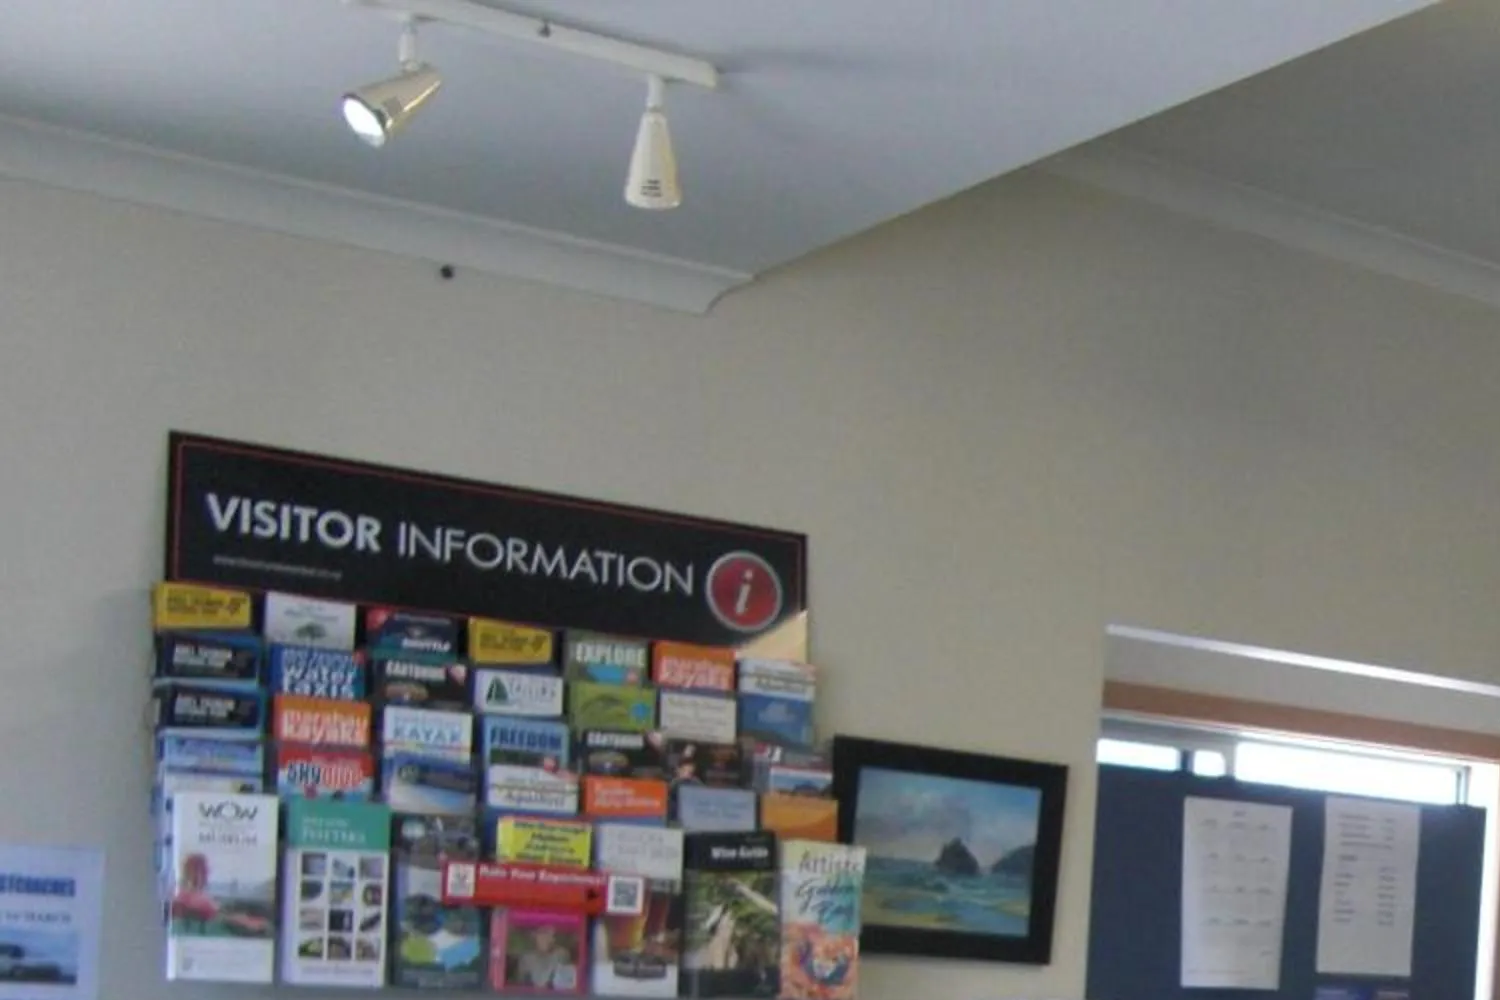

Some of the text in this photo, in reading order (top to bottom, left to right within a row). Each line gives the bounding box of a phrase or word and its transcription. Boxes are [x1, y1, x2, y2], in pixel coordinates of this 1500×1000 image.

[206, 492, 694, 597] VISITOR INFORMATION
[575, 641, 647, 668] EXPLORE
[198, 801, 259, 821] WOW
